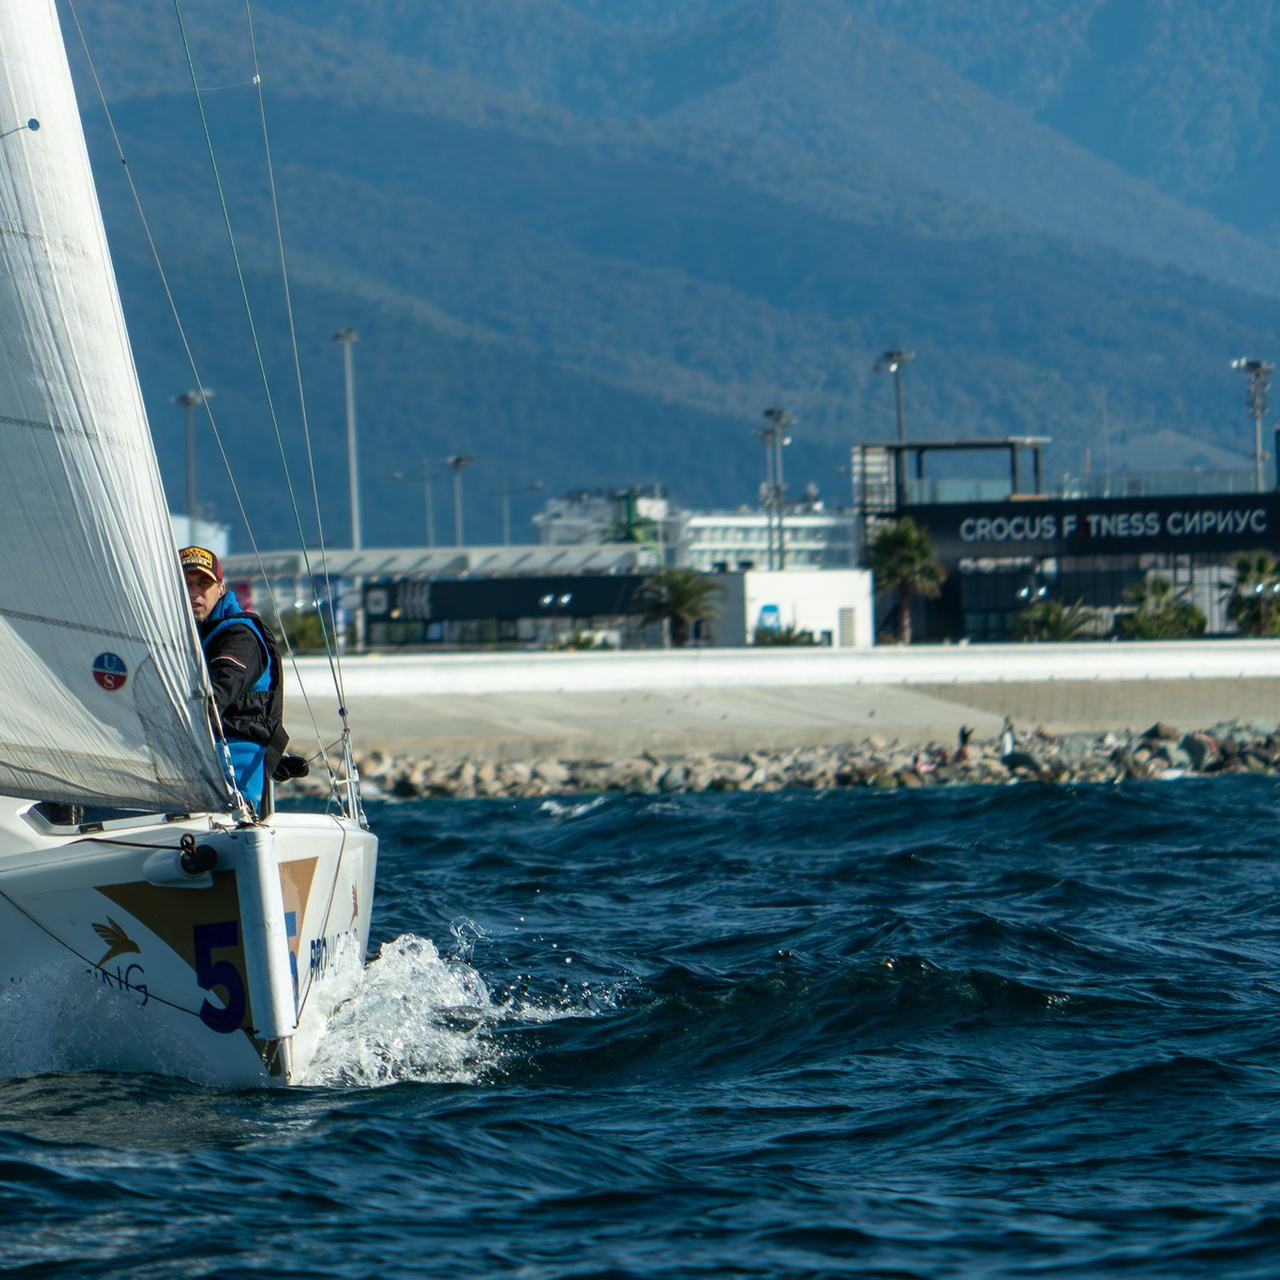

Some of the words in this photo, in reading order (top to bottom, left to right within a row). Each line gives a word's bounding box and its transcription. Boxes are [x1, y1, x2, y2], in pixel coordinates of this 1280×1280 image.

[960, 515, 1057, 542] CROCUS
[1166, 509, 1267, 535] СИРИУС
[193, 921, 246, 1034] 5
